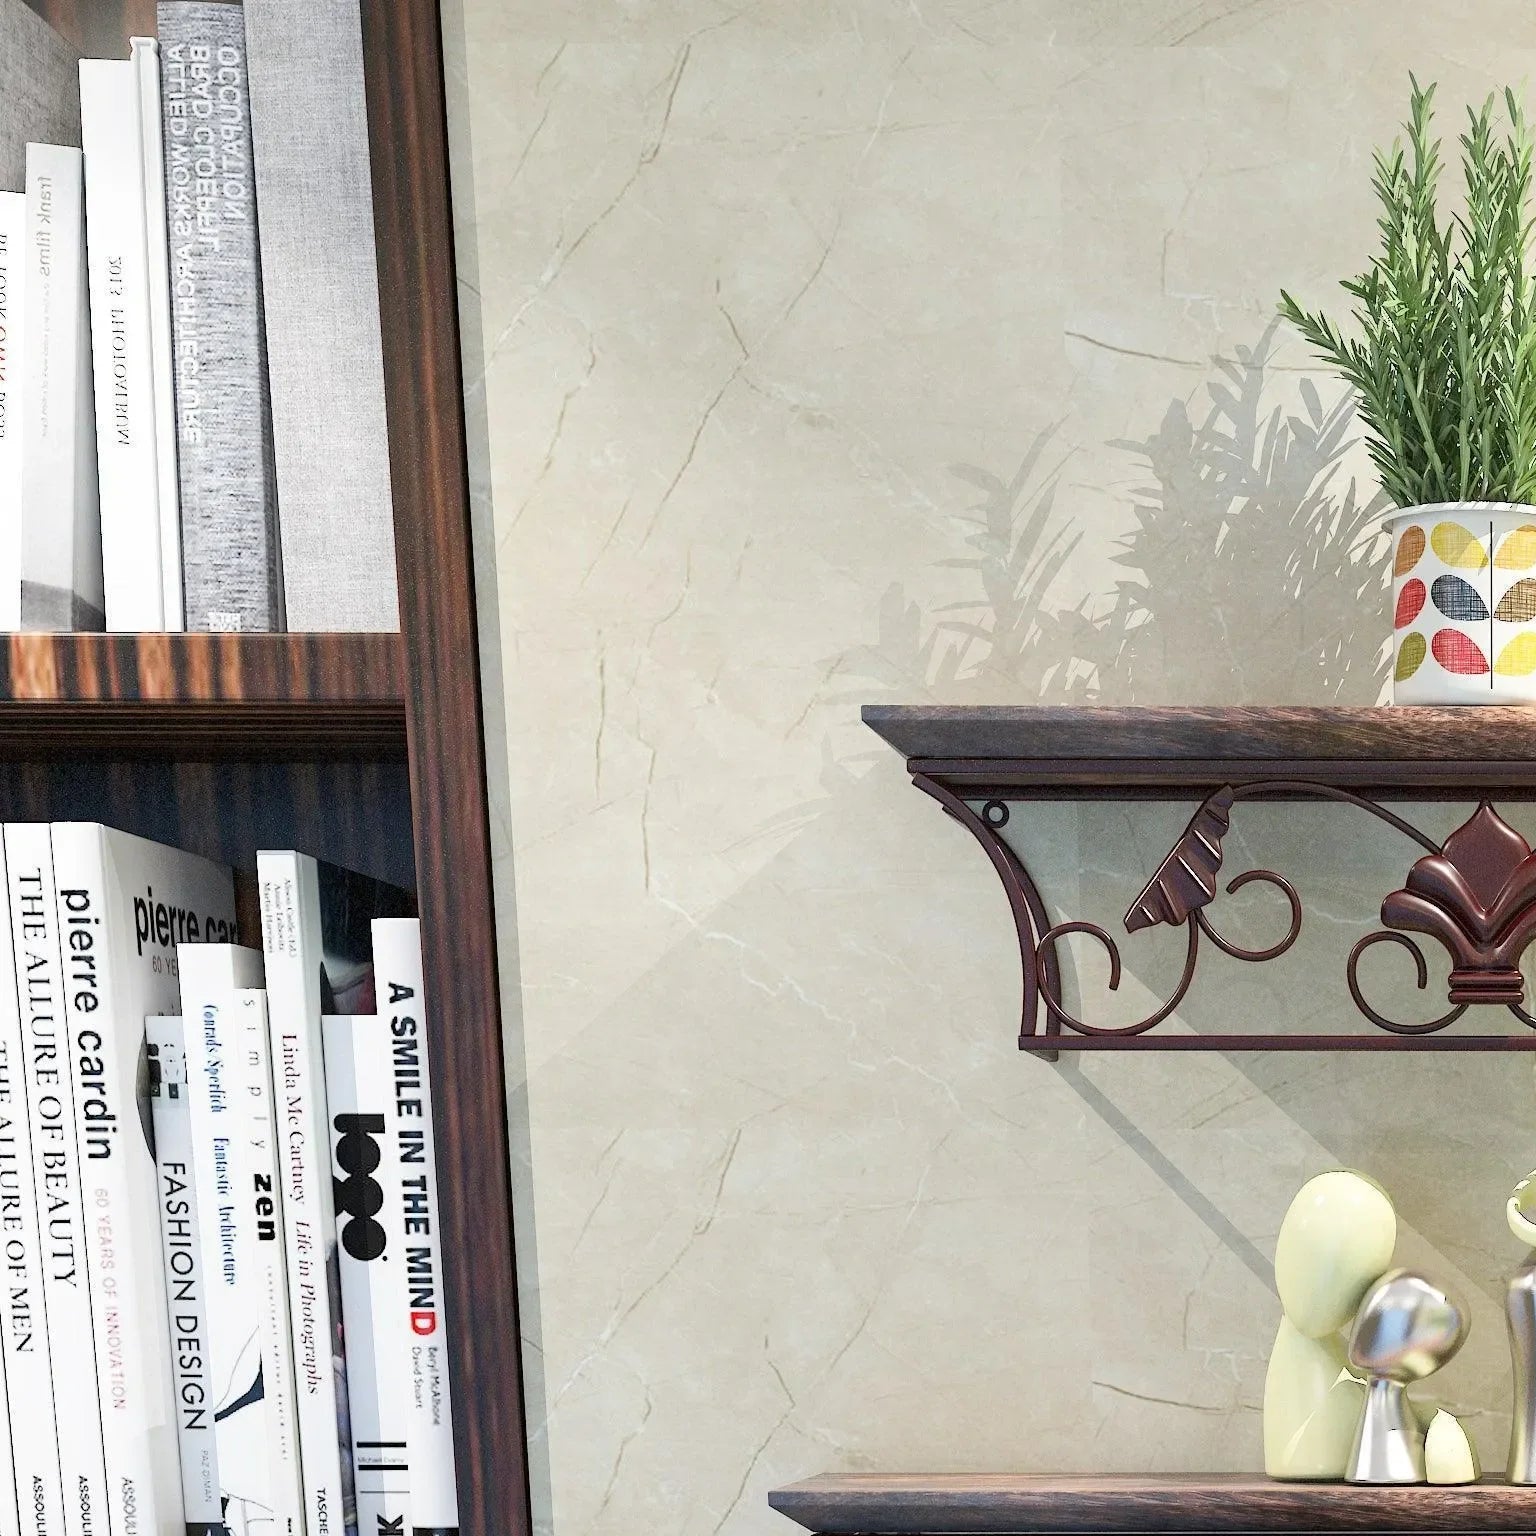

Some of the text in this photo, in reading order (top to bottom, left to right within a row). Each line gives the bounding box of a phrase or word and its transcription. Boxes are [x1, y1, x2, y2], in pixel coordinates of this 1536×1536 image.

[134, 886, 200, 956] pierre
[60, 889, 116, 1159] pierre cardin
[19, 868, 77, 1288] THE ALLURE OF BEAUTY
[282, 1035, 300, 1089] Linda
[388, 982, 436, 1335] A SMILE IN THE MIND
[254, 1173, 276, 1241] zen
[296, 1221, 312, 1255] Life
[6, 1239, 27, 1279] OF
[299, 1260, 314, 1276] in
[10, 1287, 34, 1352] MEN
[94, 1187, 126, 1410] 60 YEARS OF INNOVATION
[162, 1162, 207, 1430] FASHION DESIGN
[300, 1283, 322, 1394] Photographs
